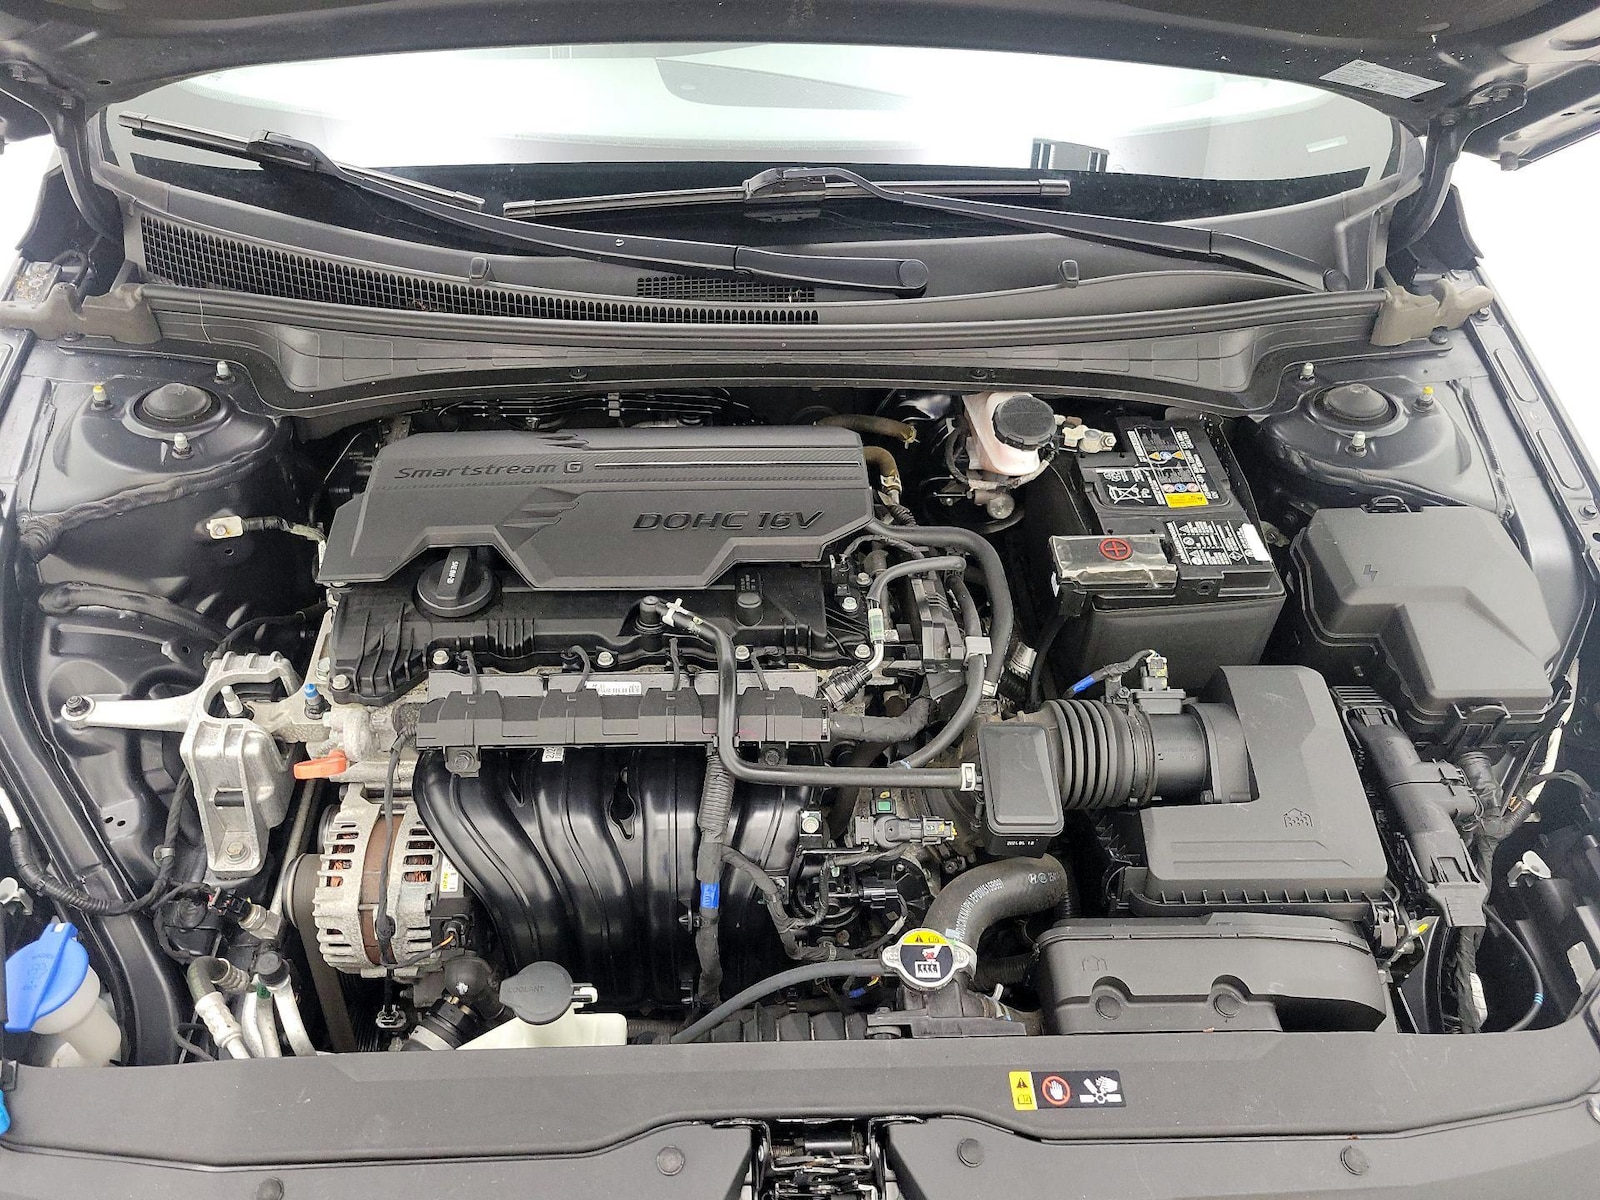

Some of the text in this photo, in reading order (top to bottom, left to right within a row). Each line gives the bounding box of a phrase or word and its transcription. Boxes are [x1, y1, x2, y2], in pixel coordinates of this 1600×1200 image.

[394, 461, 583, 479] Smartstream G
[632, 510, 824, 531] DOHC 16V
